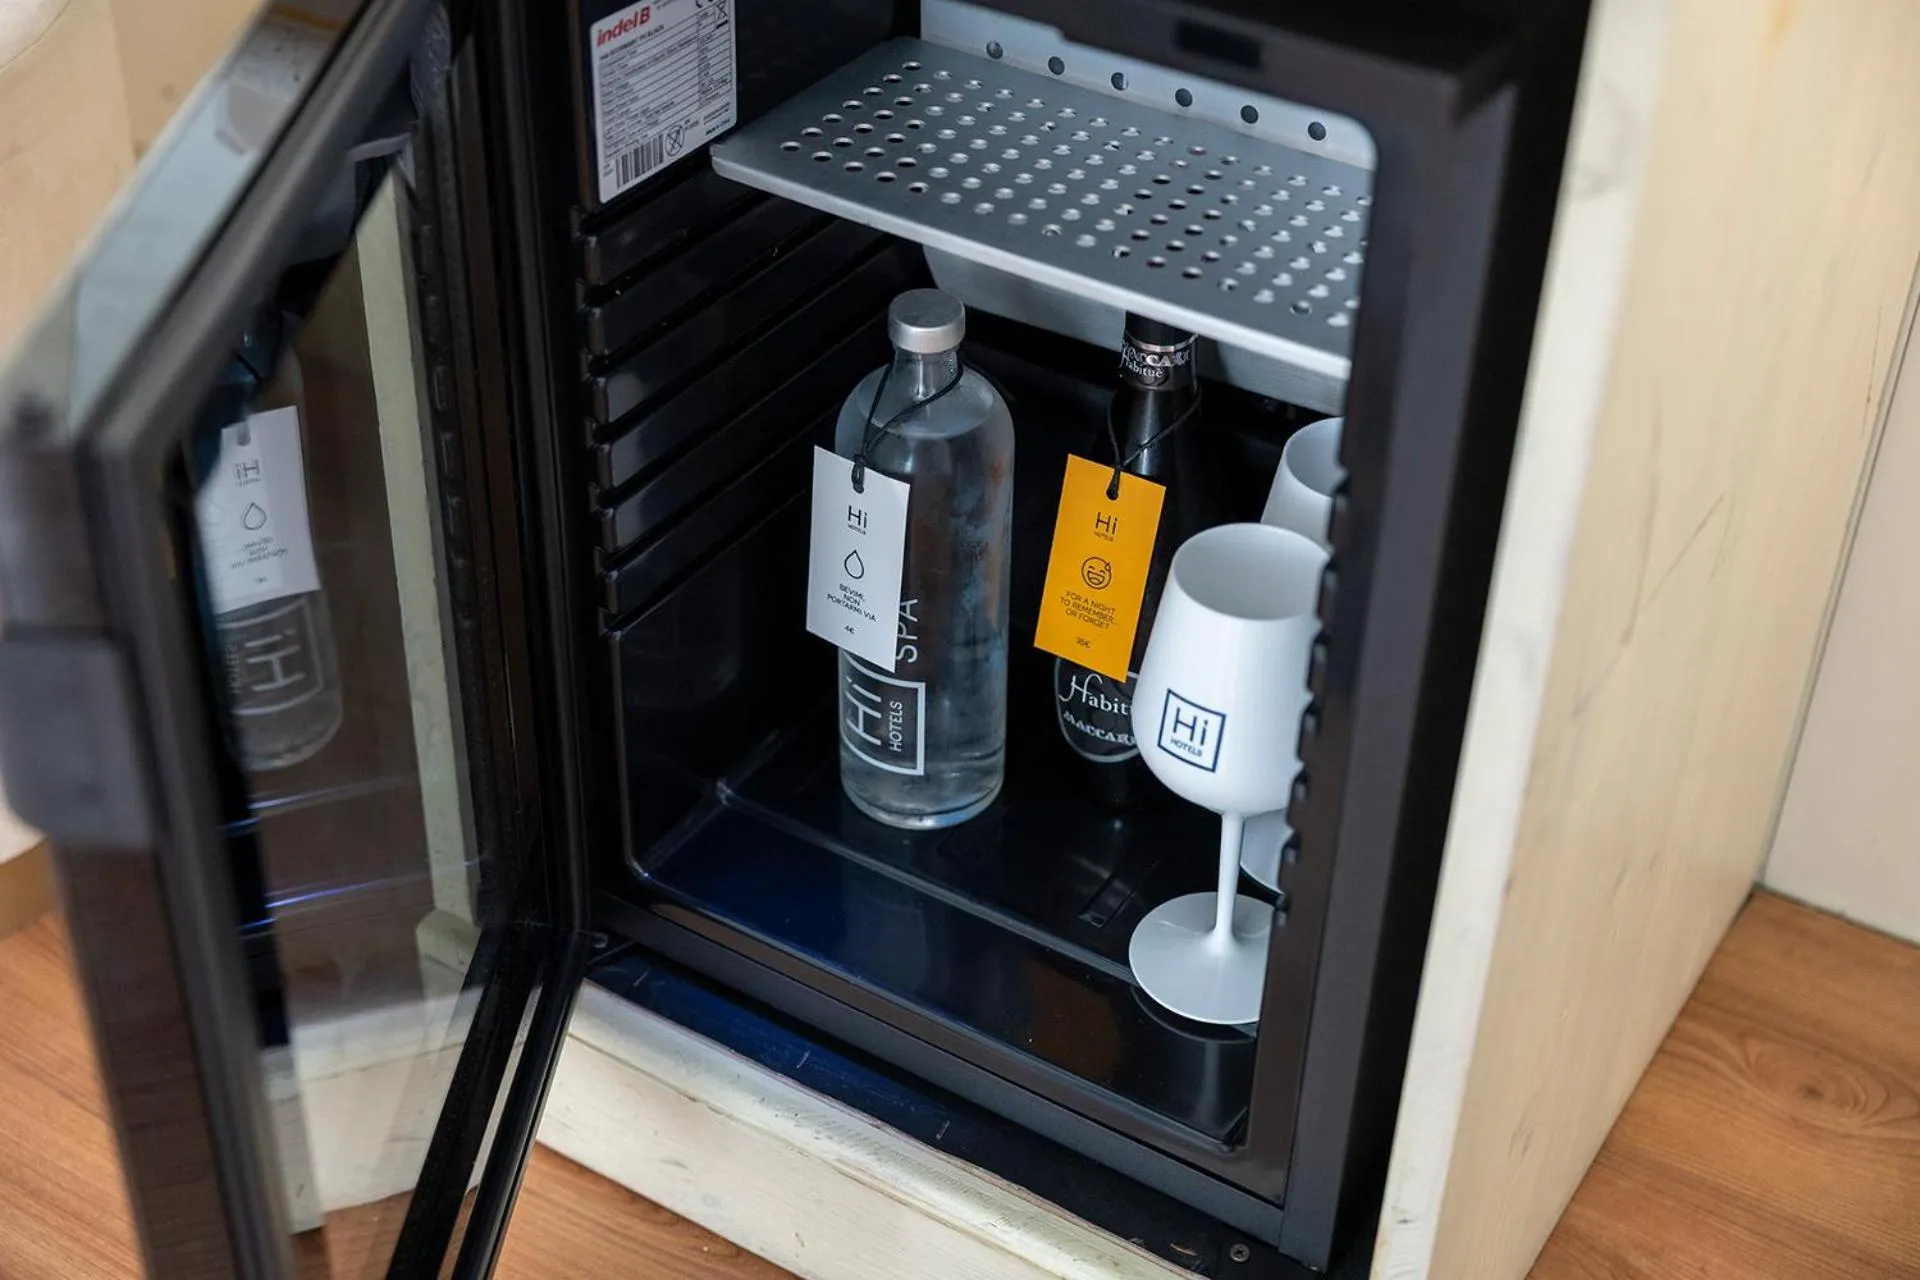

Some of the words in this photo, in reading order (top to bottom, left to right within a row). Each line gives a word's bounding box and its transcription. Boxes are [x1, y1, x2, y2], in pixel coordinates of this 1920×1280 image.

[848, 505, 868, 529] Hi
[1095, 511, 1118, 535] Hi
[844, 593, 861, 607] NON
[1060, 596, 1071, 608] TO
[1065, 590, 1082, 603] FOR
[1084, 597, 1089, 606] A
[1091, 600, 1116, 616] NIGHT
[863, 610, 877, 622] VIA
[1065, 607, 1078, 618] OR
[1078, 611, 1111, 630] FORGET
[895, 598, 919, 664] SPA
[1058, 672, 1131, 716] Habit
[845, 675, 882, 747] Hi
[888, 700, 903, 753] HOTELS
[1173, 706, 1208, 746] Hi
[1170, 737, 1203, 757] HOTELS
